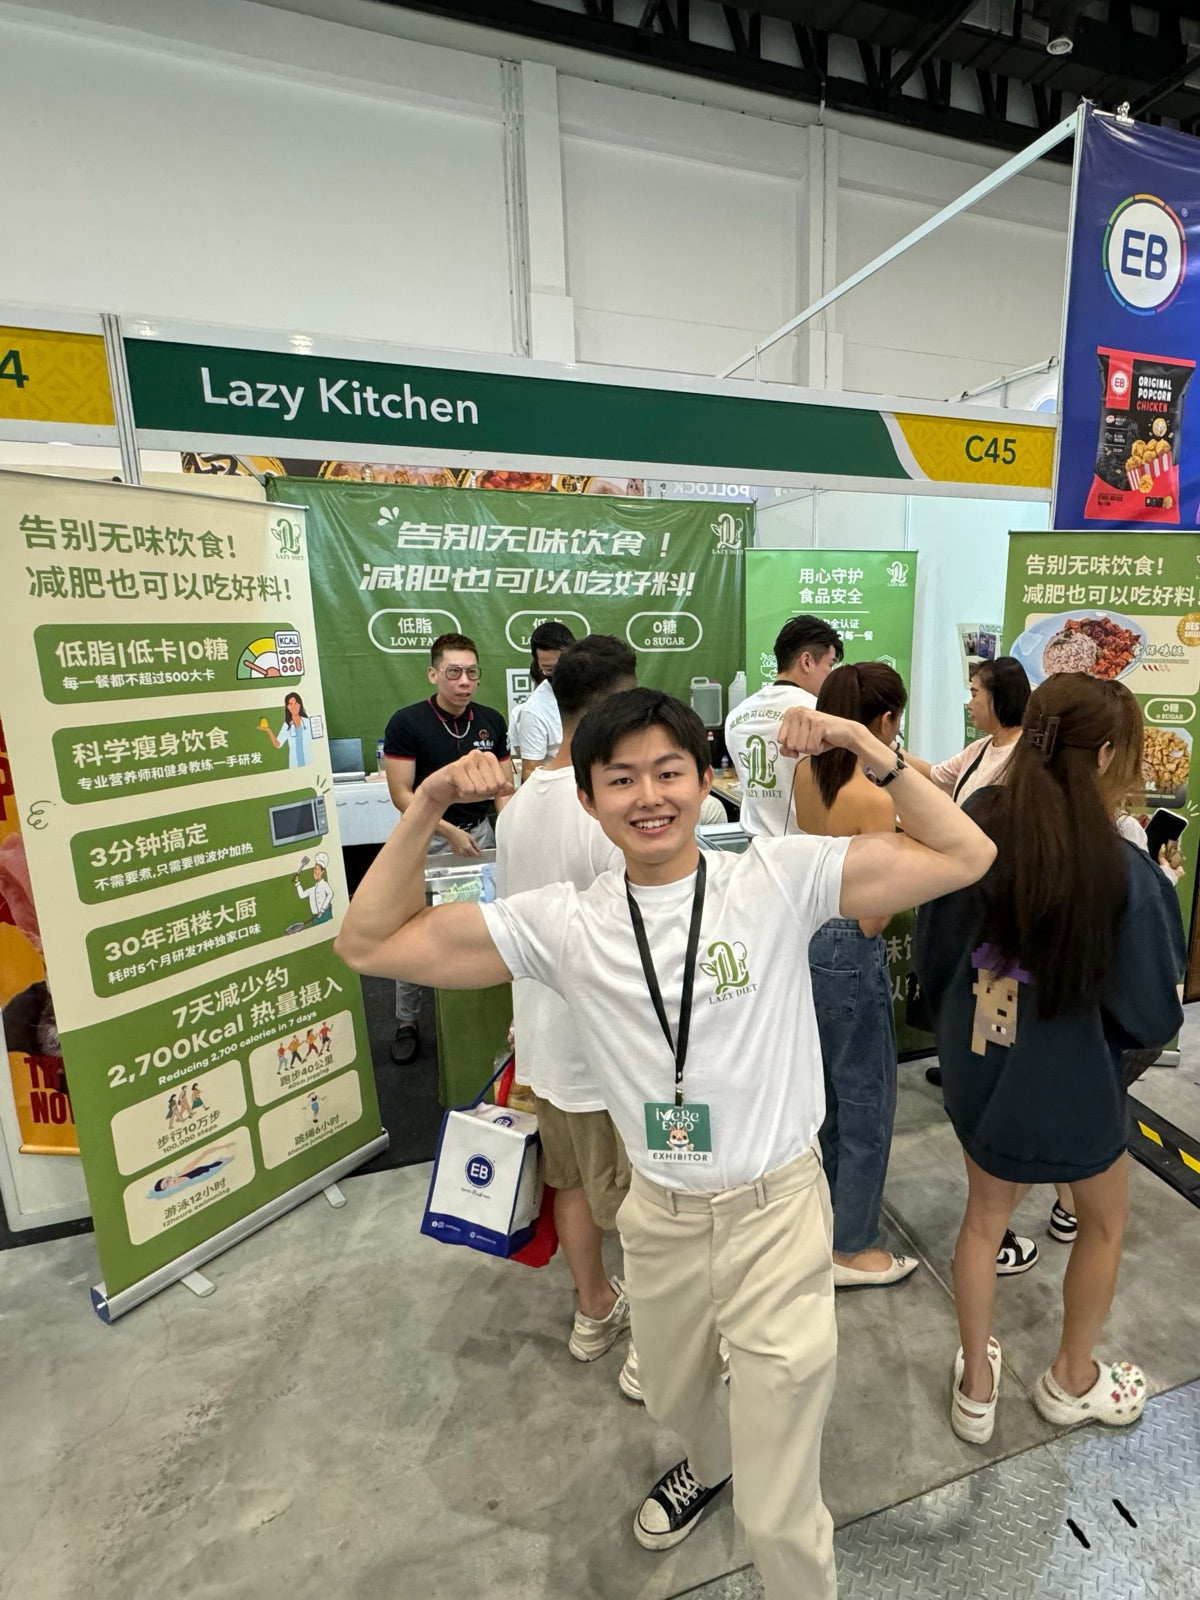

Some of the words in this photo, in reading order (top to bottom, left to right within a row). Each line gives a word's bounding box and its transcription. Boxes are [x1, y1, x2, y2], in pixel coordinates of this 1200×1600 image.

[1121, 229, 1168, 281] EB
[200, 367, 304, 421] Lazy
[319, 377, 479, 425] Kitchen
[1138, 376, 1172, 390] ORIGINAL
[1138, 389, 1172, 402] POPCORN
[1137, 401, 1168, 413] CHICKEN
[965, 435, 1017, 465] C45
[19, 513, 237, 559] 告别无味饮食!
[359, 562, 696, 598] 减肥也可以吃好料!
[798, 568, 864, 585] 用心守护
[1025, 554, 1164, 577] 告别无味饮食!
[26, 565, 292, 602] 减肥也可以吃好料!
[798, 588, 864, 605] 食品安全
[390, 636, 418, 646] LOW
[397, 617, 432, 634] 低脂
[652, 636, 685, 646] SUGAR
[653, 620, 677, 635] 0糖
[279, 637, 298, 647] KCAL
[62, 669, 215, 690] 每一餐都不超过500大卡
[72, 726, 229, 769] 科学瘦身饮食
[77, 752, 263, 791] 专业营养师和健身教练一手研发
[89, 823, 209, 868] 3分钟搞定
[104, 896, 257, 962] 30年酒楼大厨
[108, 924, 262, 985] 耗时5个月研发7种独家口味
[172, 966, 289, 1029] 7天减少约
[708, 991, 734, 1005] LAZY
[736, 983, 758, 997] DIET
[107, 1013, 244, 1088] 2,700Kcal
[251, 976, 343, 1028] 热量摄入
[158, 1059, 209, 1086] Reducing
[210, 1043, 238, 1063] 2,700
[239, 1028, 277, 1049] calories
[278, 1021, 287, 1033] in
[288, 1018, 295, 1029] 7
[296, 1010, 317, 1027] days
[279, 1054, 334, 1088] 跑步40公里
[30, 1091, 76, 1124] NO
[156, 1109, 221, 1150] 步行10万步
[197, 1122, 219, 1141] steps
[470, 1162, 489, 1180] EB
[652, 1151, 708, 1162] EXHIBITOR
[163, 1177, 226, 1220] 游泳12小时
